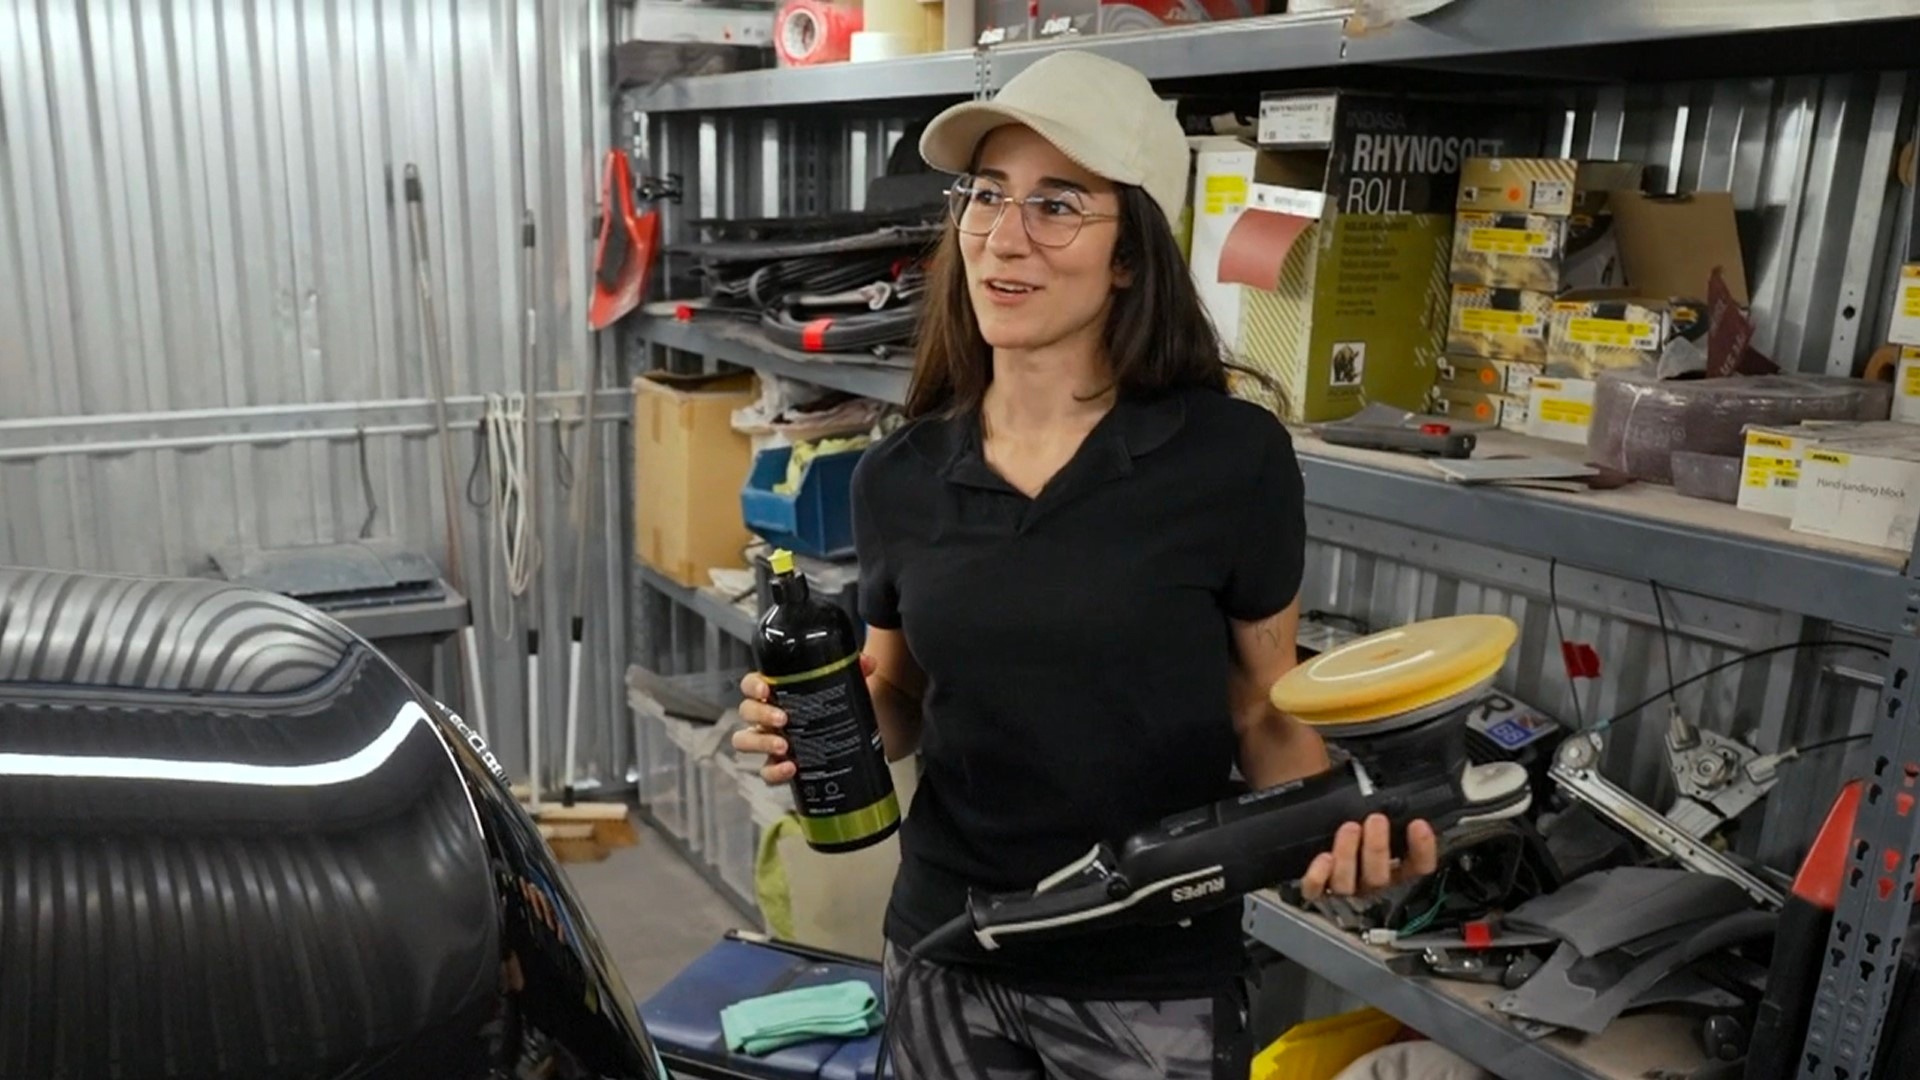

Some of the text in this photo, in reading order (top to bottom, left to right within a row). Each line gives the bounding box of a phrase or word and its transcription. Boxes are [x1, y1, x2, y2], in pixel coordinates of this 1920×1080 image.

[1346, 111, 1406, 130] INDASA
[1346, 177, 1412, 215] ROLL
[1817, 477, 1907, 500] Hand sanding block
[1171, 877, 1226, 903] RUPES
